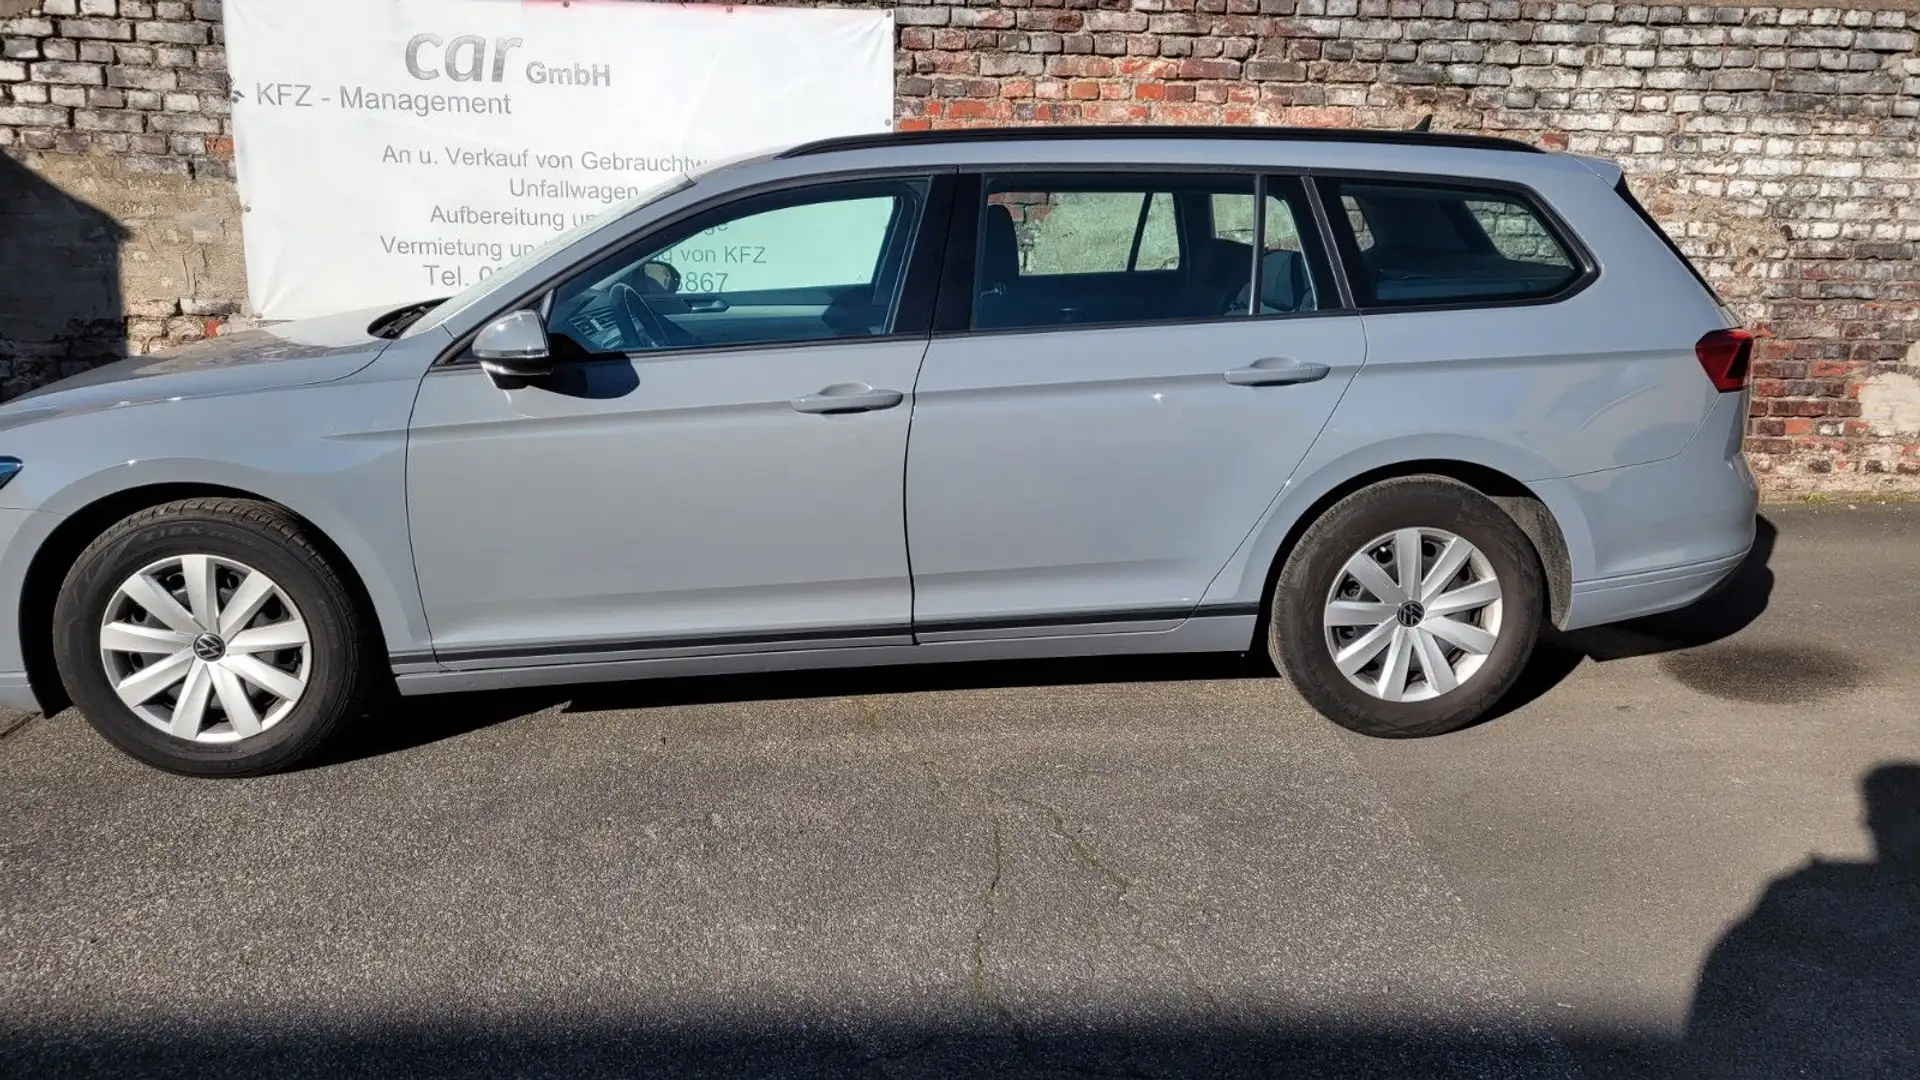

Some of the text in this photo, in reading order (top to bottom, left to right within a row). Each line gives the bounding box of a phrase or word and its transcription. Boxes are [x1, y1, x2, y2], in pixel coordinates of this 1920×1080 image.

[405, 32, 612, 87] car GmbH
[256, 82, 313, 107] KFZ
[339, 85, 512, 117] Management
[382, 145, 411, 165] An
[418, 149, 438, 165] u.
[445, 146, 529, 168] Verkauf
[536, 152, 573, 169] von
[510, 178, 639, 204] Unfallwagen
[430, 204, 565, 232] Aufbereitung
[380, 235, 502, 262] Vermietung
[510, 240, 548, 258] un
[680, 248, 717, 263] von
[724, 245, 767, 264] KFZ
[423, 264, 470, 287] Tel.
[677, 271, 730, 293] 867
